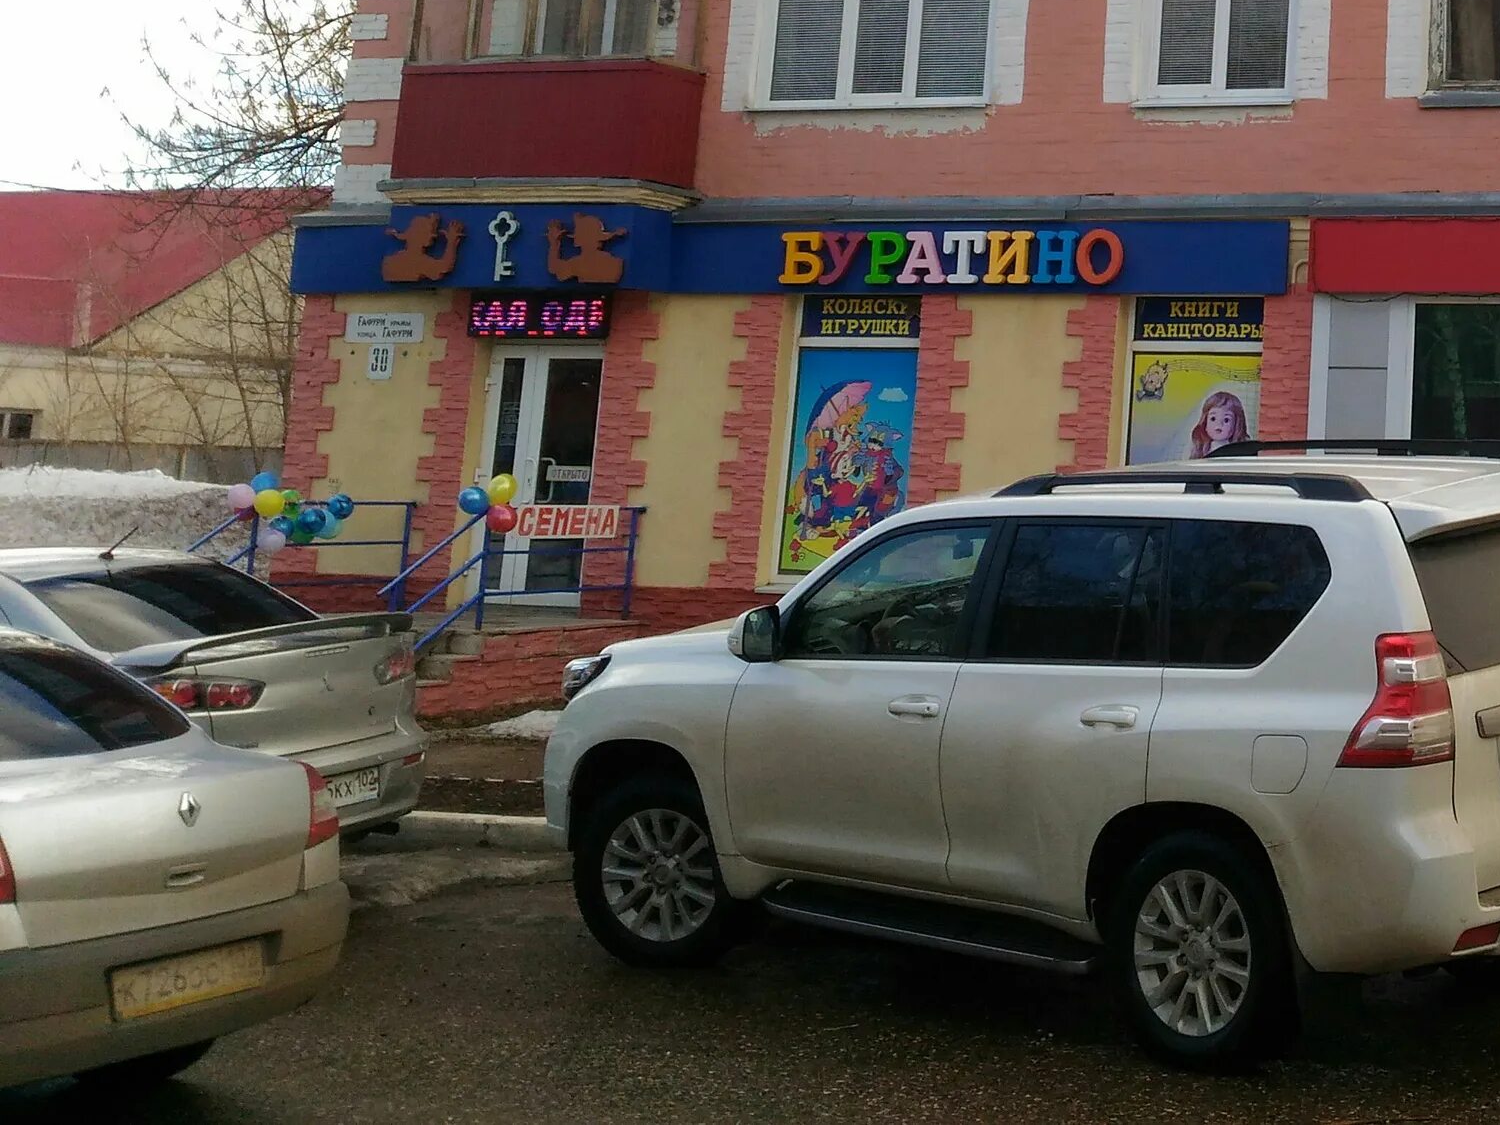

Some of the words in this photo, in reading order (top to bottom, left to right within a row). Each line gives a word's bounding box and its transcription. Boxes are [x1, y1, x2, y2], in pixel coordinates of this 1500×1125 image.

[778, 228, 1124, 286] БУРАТИНО
[1169, 301, 1240, 318] КНИГИ
[820, 319, 912, 335] ИГРУШКИ
[1143, 323, 1264, 339] КАНЦТОВАРЫ
[370, 347, 389, 372] 30
[517, 506, 617, 537] СЕМЕНА
